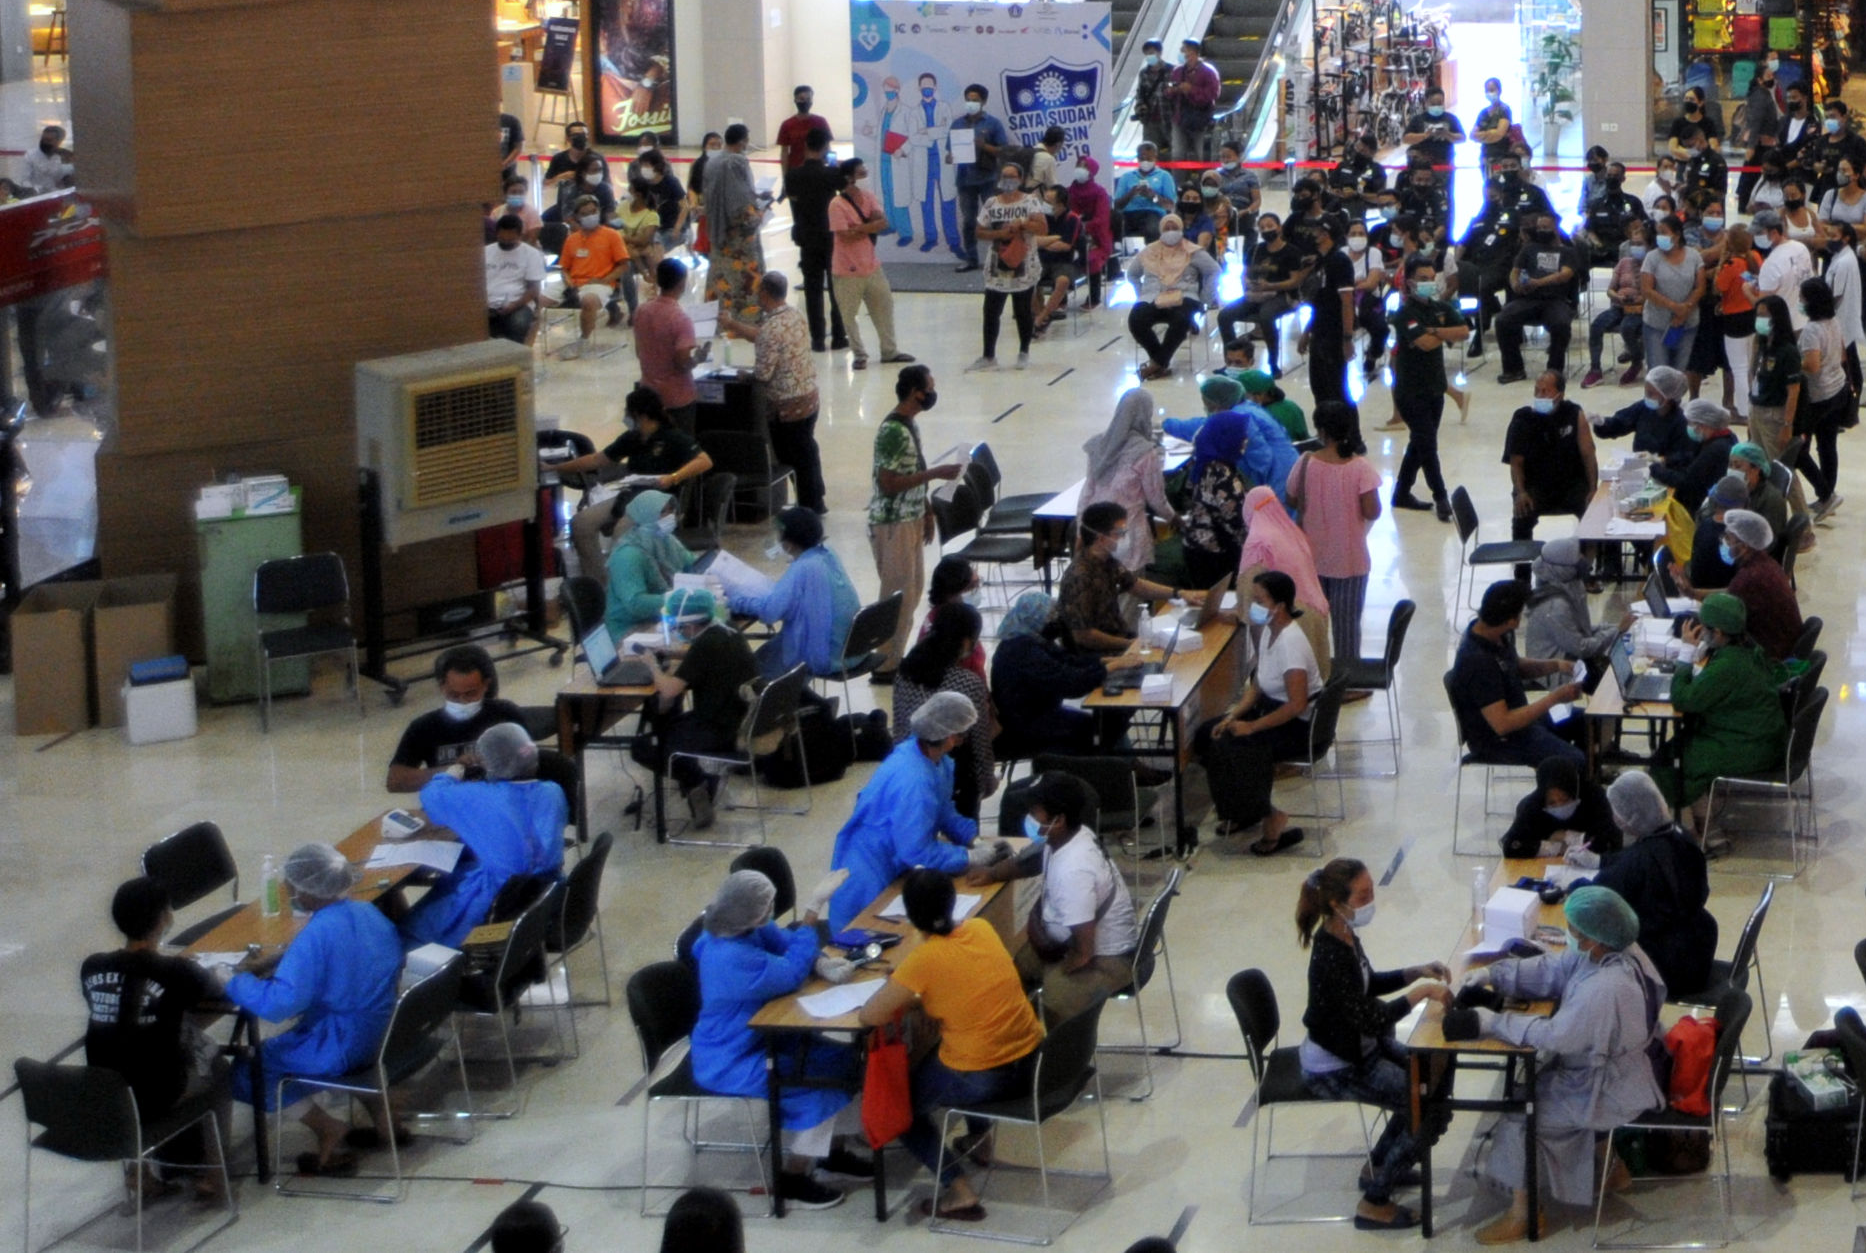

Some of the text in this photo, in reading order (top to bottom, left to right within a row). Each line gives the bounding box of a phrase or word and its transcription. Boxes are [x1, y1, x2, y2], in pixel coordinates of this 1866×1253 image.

[1008, 106, 1096, 131] SAYA SUDAH
[1022, 125, 1089, 148] DIVSIN
